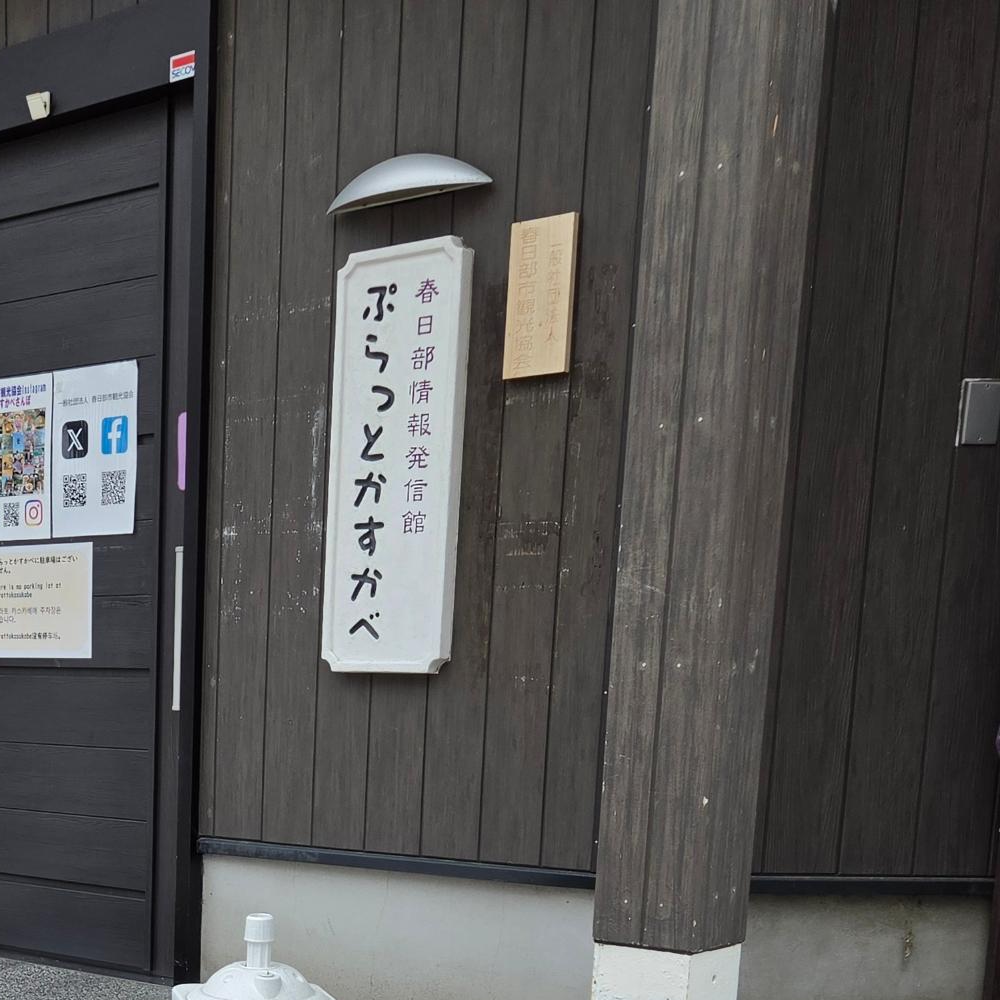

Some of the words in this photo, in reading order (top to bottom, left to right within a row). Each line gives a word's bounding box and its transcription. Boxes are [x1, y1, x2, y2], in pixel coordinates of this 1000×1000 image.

[348, 283, 397, 640] ぷらっとかすかべ
[401, 278, 439, 535] 春日部情報発信館
